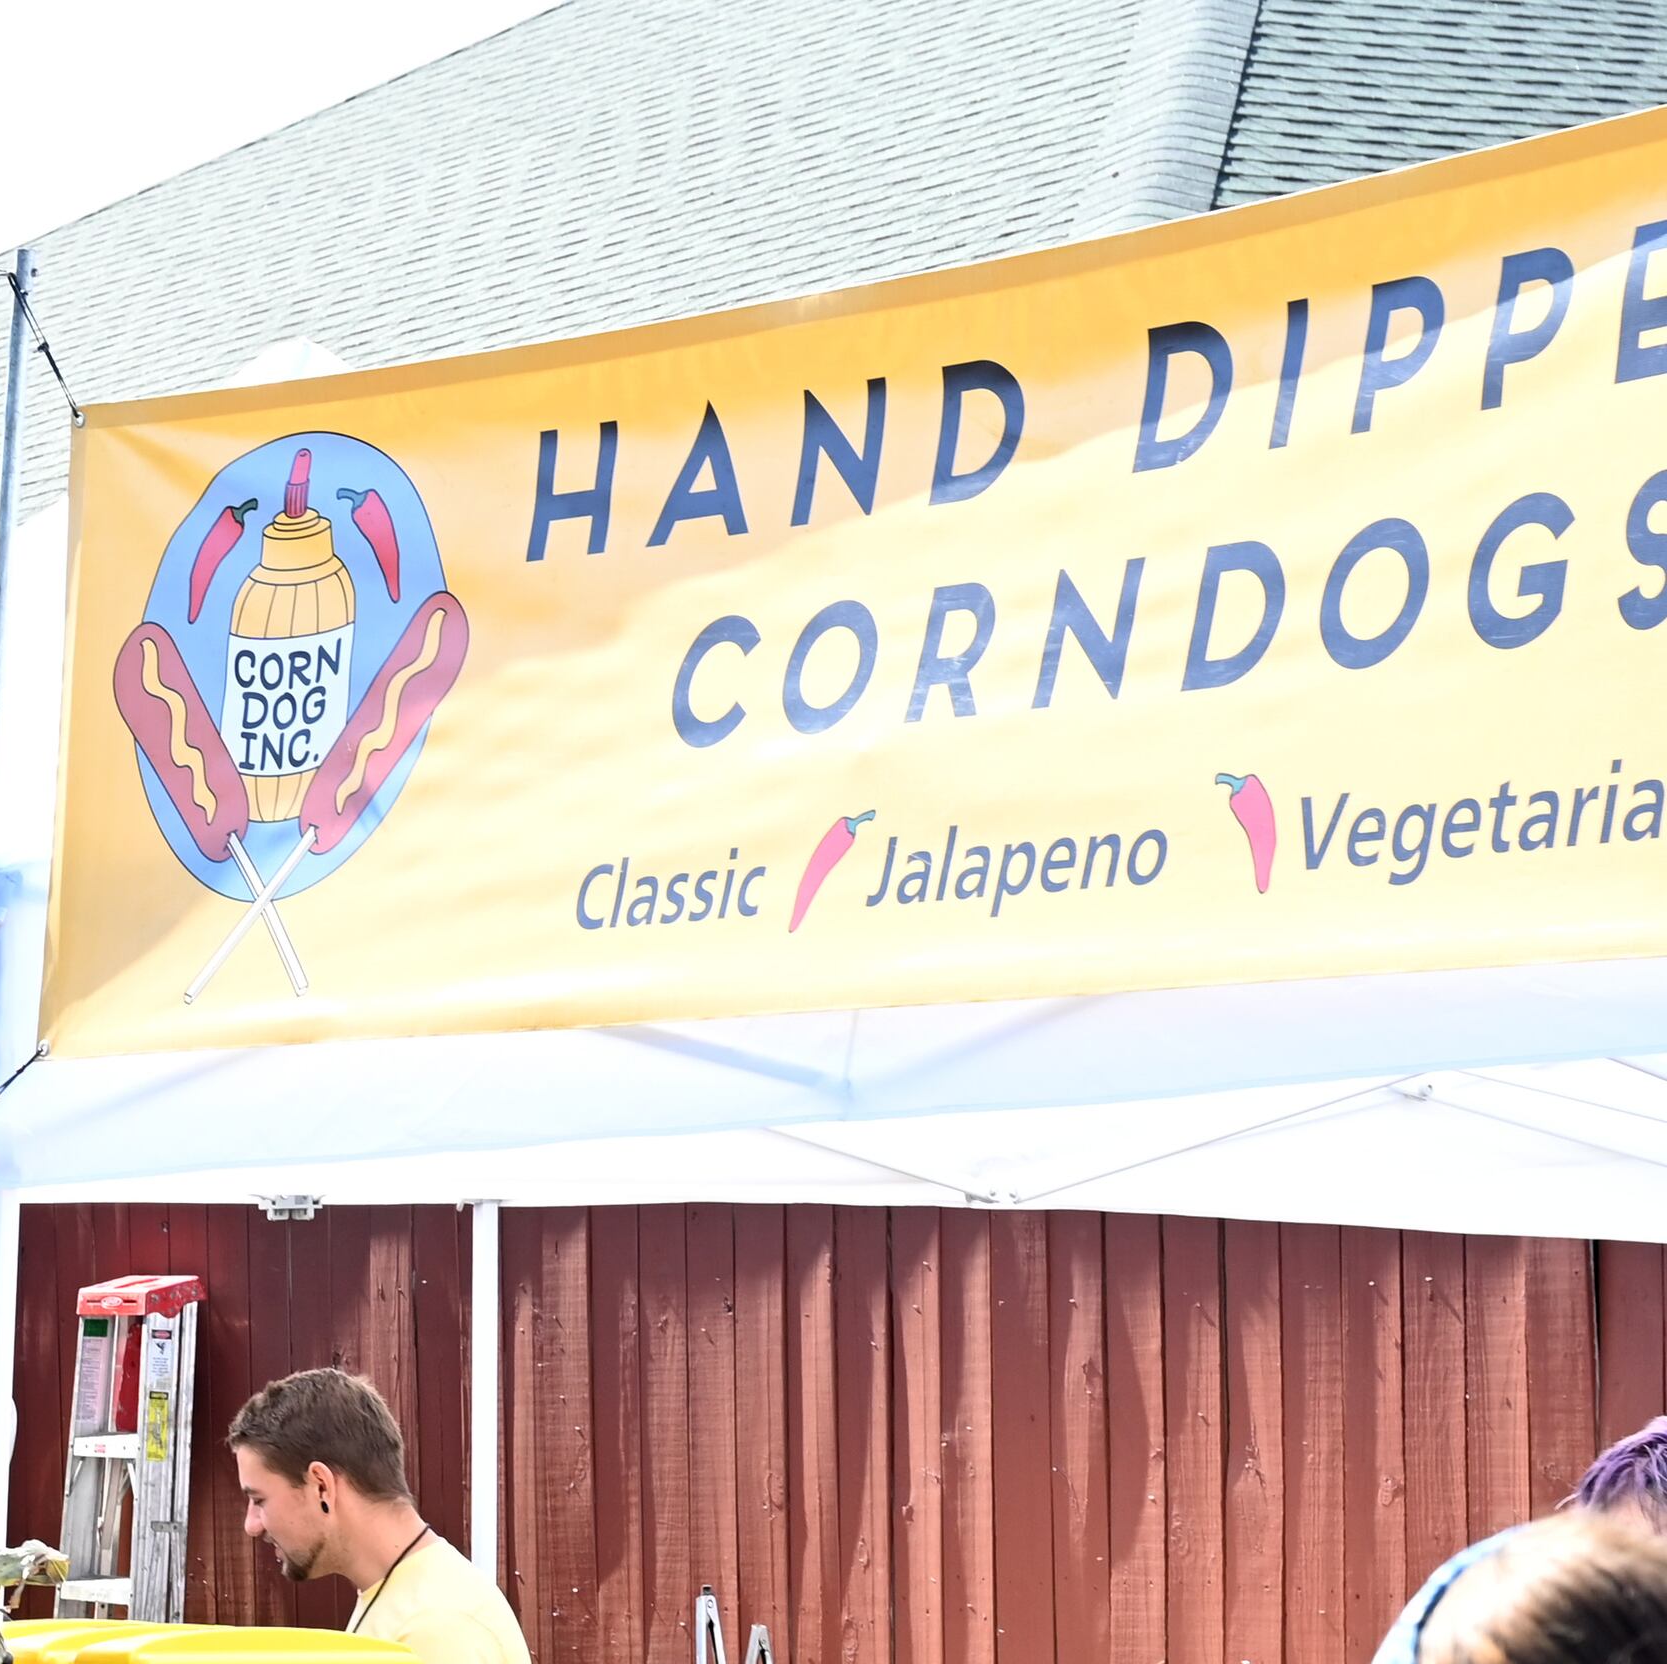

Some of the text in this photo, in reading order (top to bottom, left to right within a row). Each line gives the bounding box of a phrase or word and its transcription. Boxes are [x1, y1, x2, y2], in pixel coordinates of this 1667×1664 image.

[526, 359, 1025, 562] HAND
[234, 637, 342, 691] CORN
[671, 468, 1667, 749] CORNDOGS
[239, 728, 319, 771] INC.
[242, 685, 327, 731] DOG
[575, 757, 1667, 933] Classic Jalapeno Vegetaria
